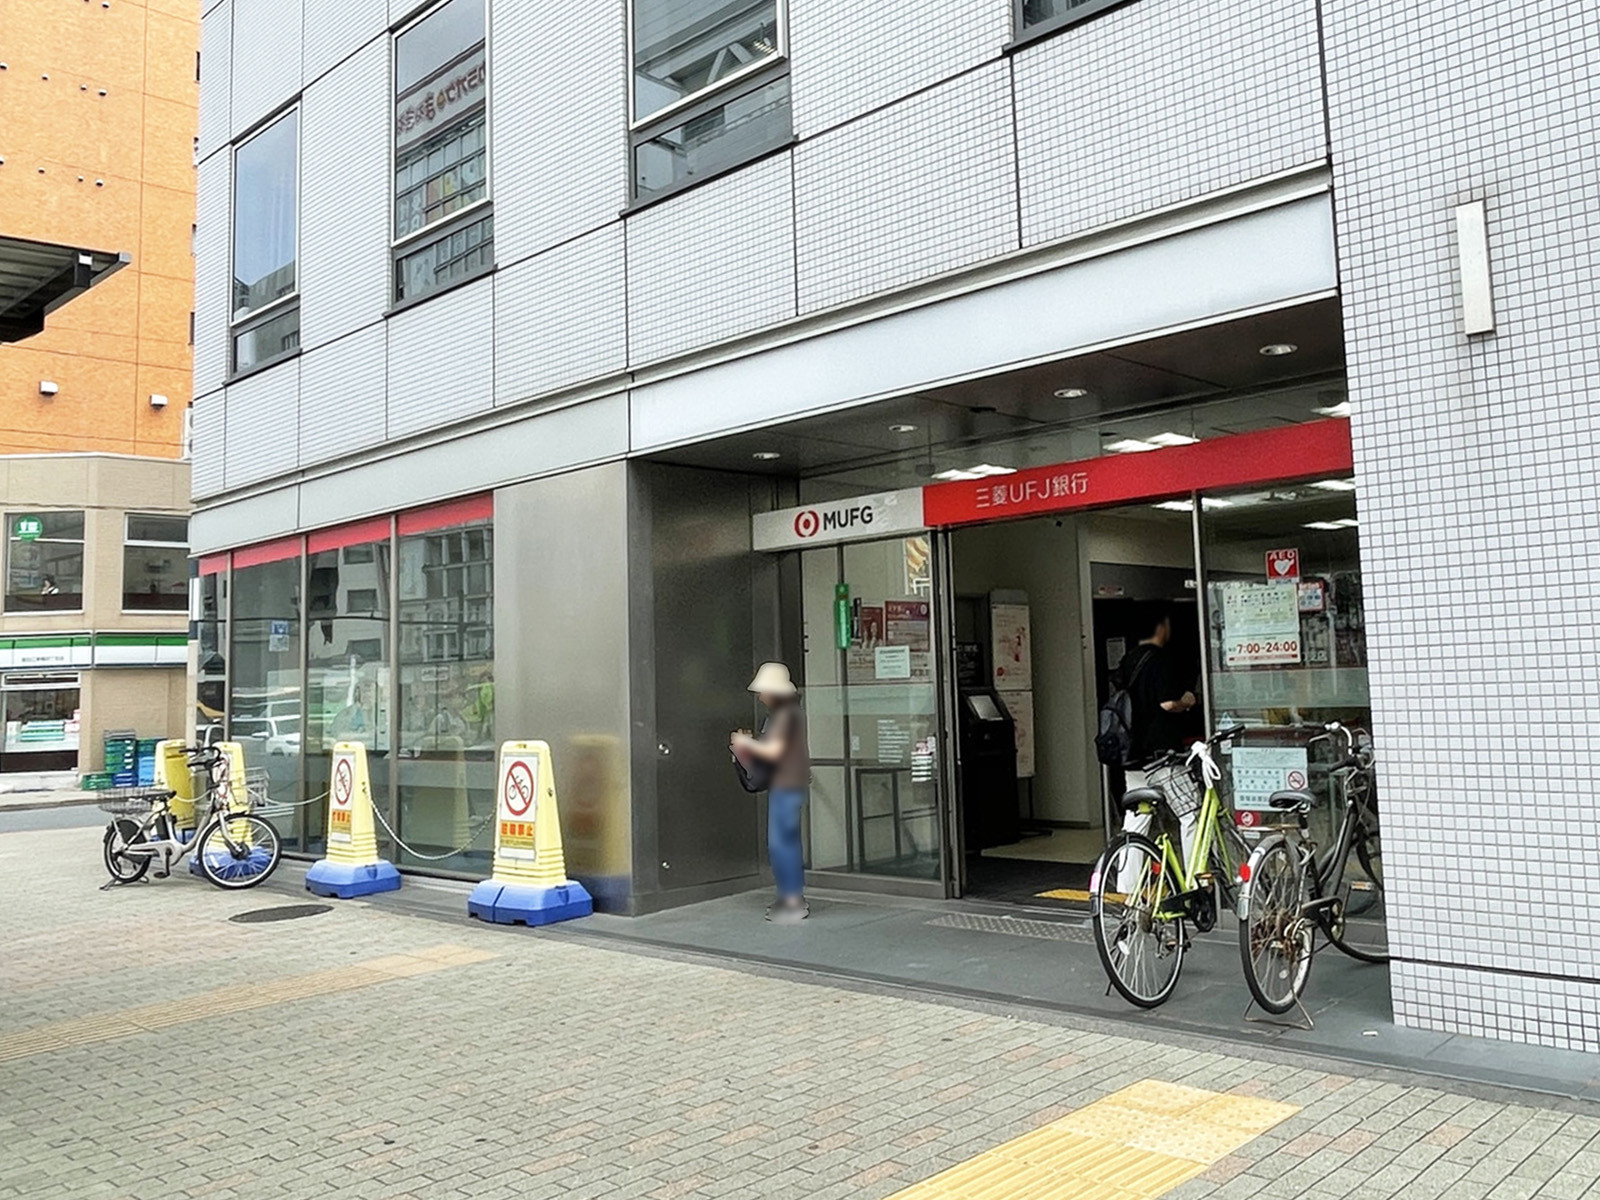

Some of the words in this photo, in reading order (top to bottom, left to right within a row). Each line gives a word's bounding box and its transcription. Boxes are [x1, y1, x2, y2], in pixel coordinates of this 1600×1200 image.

[976, 472, 1089, 508] 三菱UFJ銀行
[823, 505, 873, 531] MUFG
[1269, 550, 1295, 561] AED
